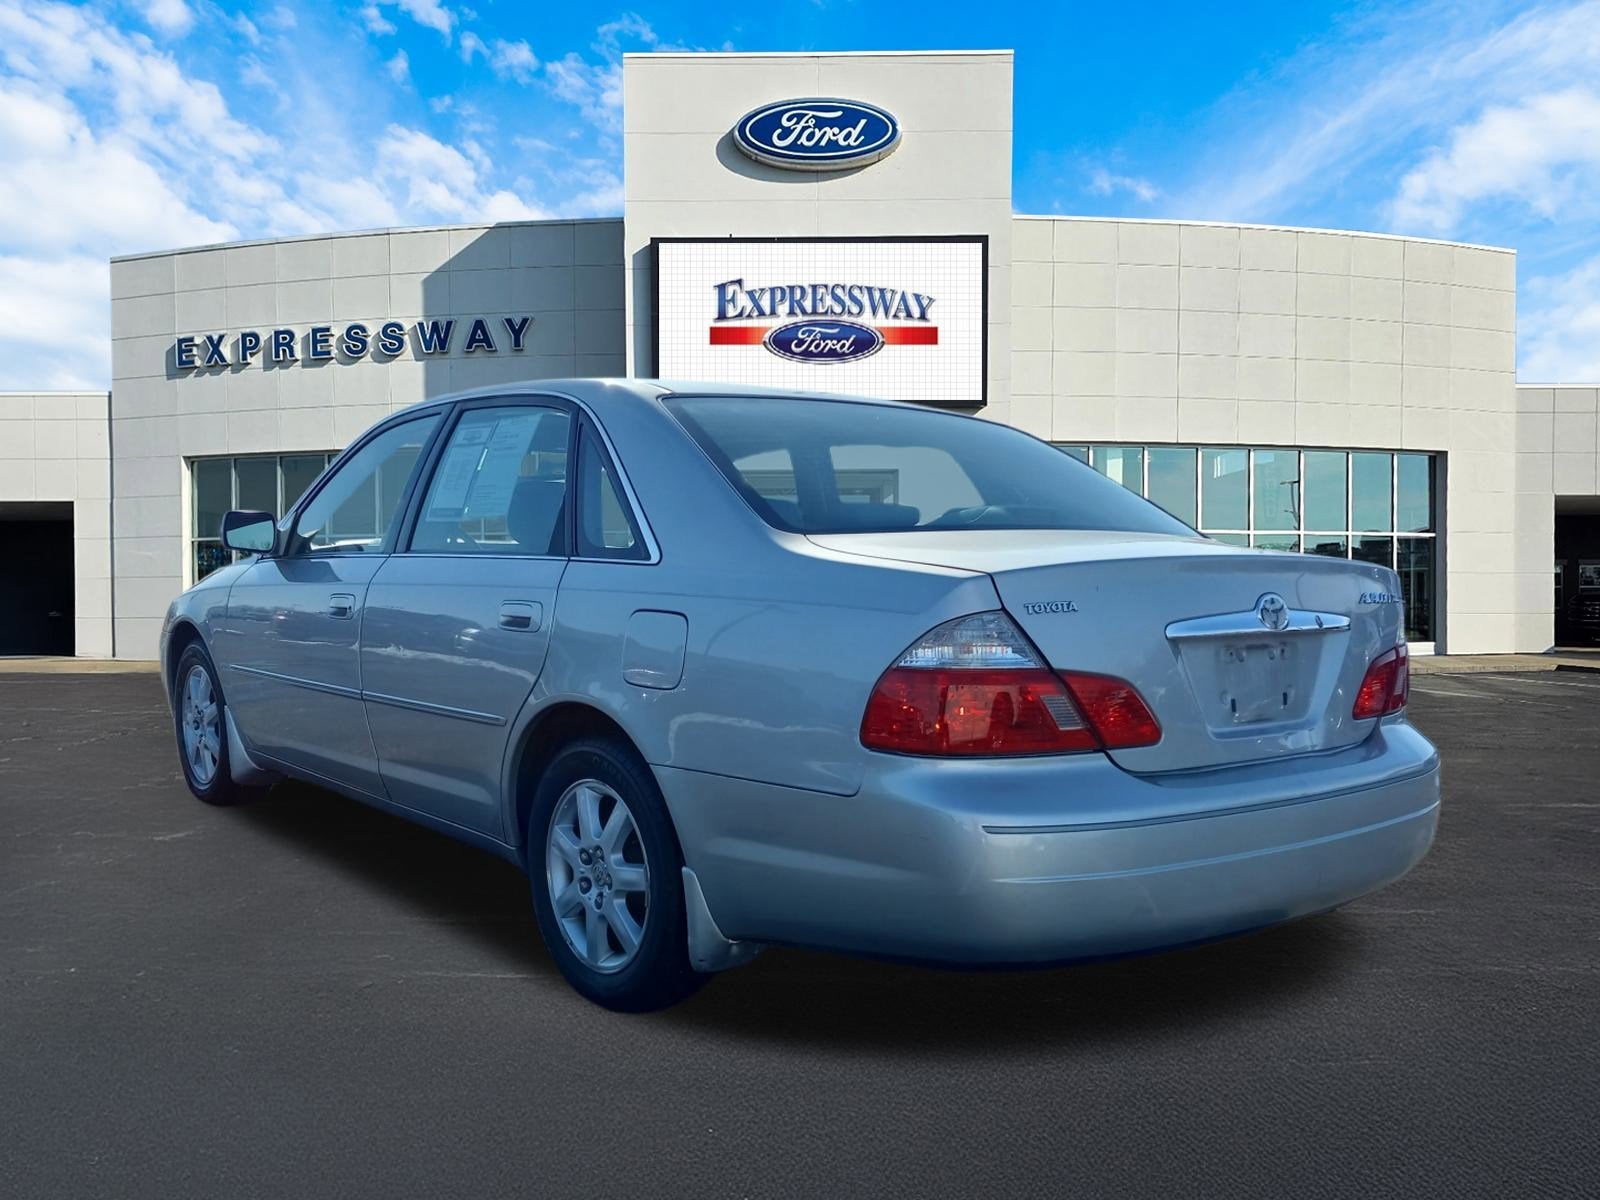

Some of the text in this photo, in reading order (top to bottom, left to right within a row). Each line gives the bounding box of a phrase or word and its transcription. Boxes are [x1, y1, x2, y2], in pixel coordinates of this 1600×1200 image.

[772, 109, 866, 147] Ford
[713, 278, 936, 322] EXPRESSWAY
[175, 316, 532, 368] EXPRESSWAY
[790, 326, 856, 354] Ford
[1023, 600, 1079, 615] TOYOTA
